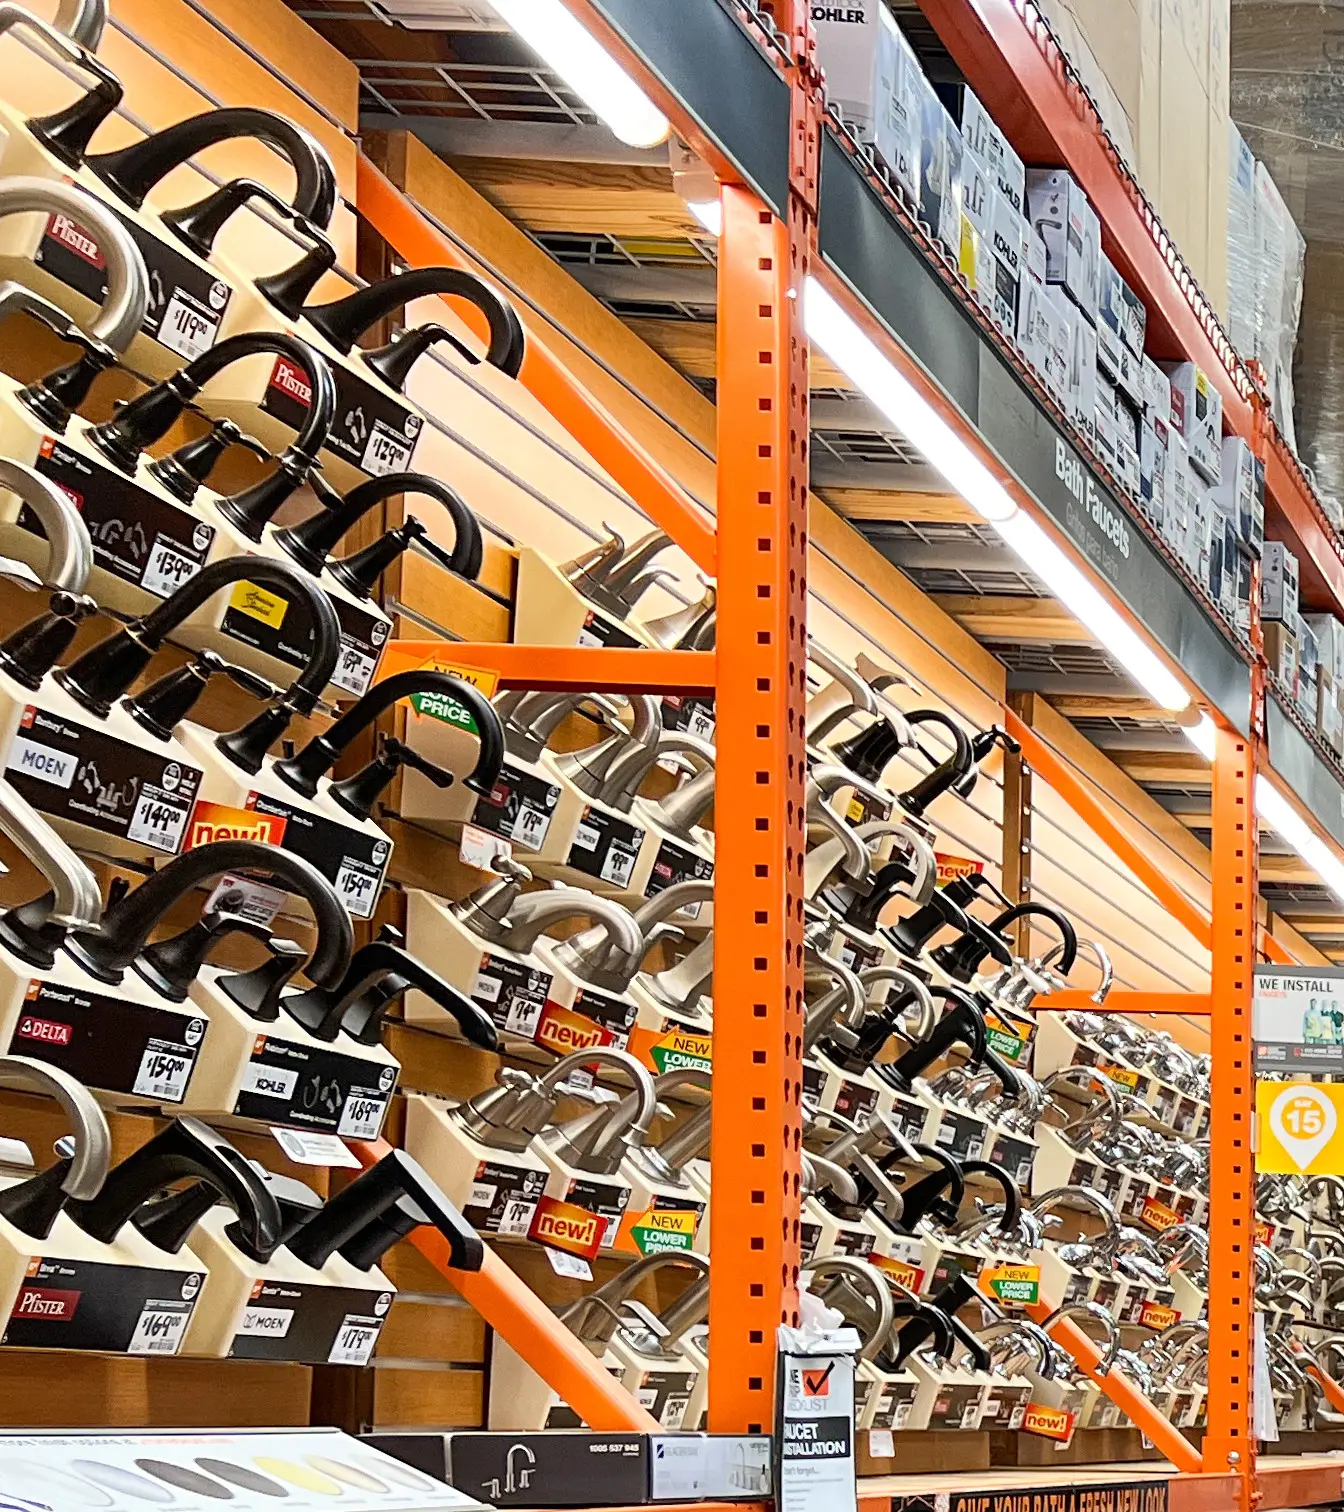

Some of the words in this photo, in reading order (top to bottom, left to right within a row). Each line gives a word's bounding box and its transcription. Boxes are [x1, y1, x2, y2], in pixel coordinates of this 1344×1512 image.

[993, 230, 1018, 267] KOHLER
[1056, 437, 1084, 505] Bath
[1085, 475, 1130, 559] Faucets
[419, 698, 471, 726] PRICE
[22, 749, 67, 777] MOEN
[1259, 978, 1279, 991] WE
[1283, 979, 1334, 994] INSTALL
[32, 1022, 68, 1041] DELTA
[542, 1017, 600, 1047] new!
[989, 1031, 1021, 1049] LOWER
[674, 1037, 711, 1056] NEW
[664, 1051, 712, 1070] LOWER
[1286, 1109, 1323, 1134] 15
[650, 1215, 684, 1230] NEW
[1142, 1207, 1178, 1226] new!
[539, 1213, 595, 1244] new!
[643, 1229, 687, 1248] LOWER
[1003, 1269, 1030, 1281] NEW
[999, 1280, 1035, 1293] LOWER
[1001, 1288, 1031, 1300] PRICE
[255, 1313, 286, 1331] MOEN
[1142, 1309, 1176, 1326] new!
[1027, 1414, 1067, 1432] new!
